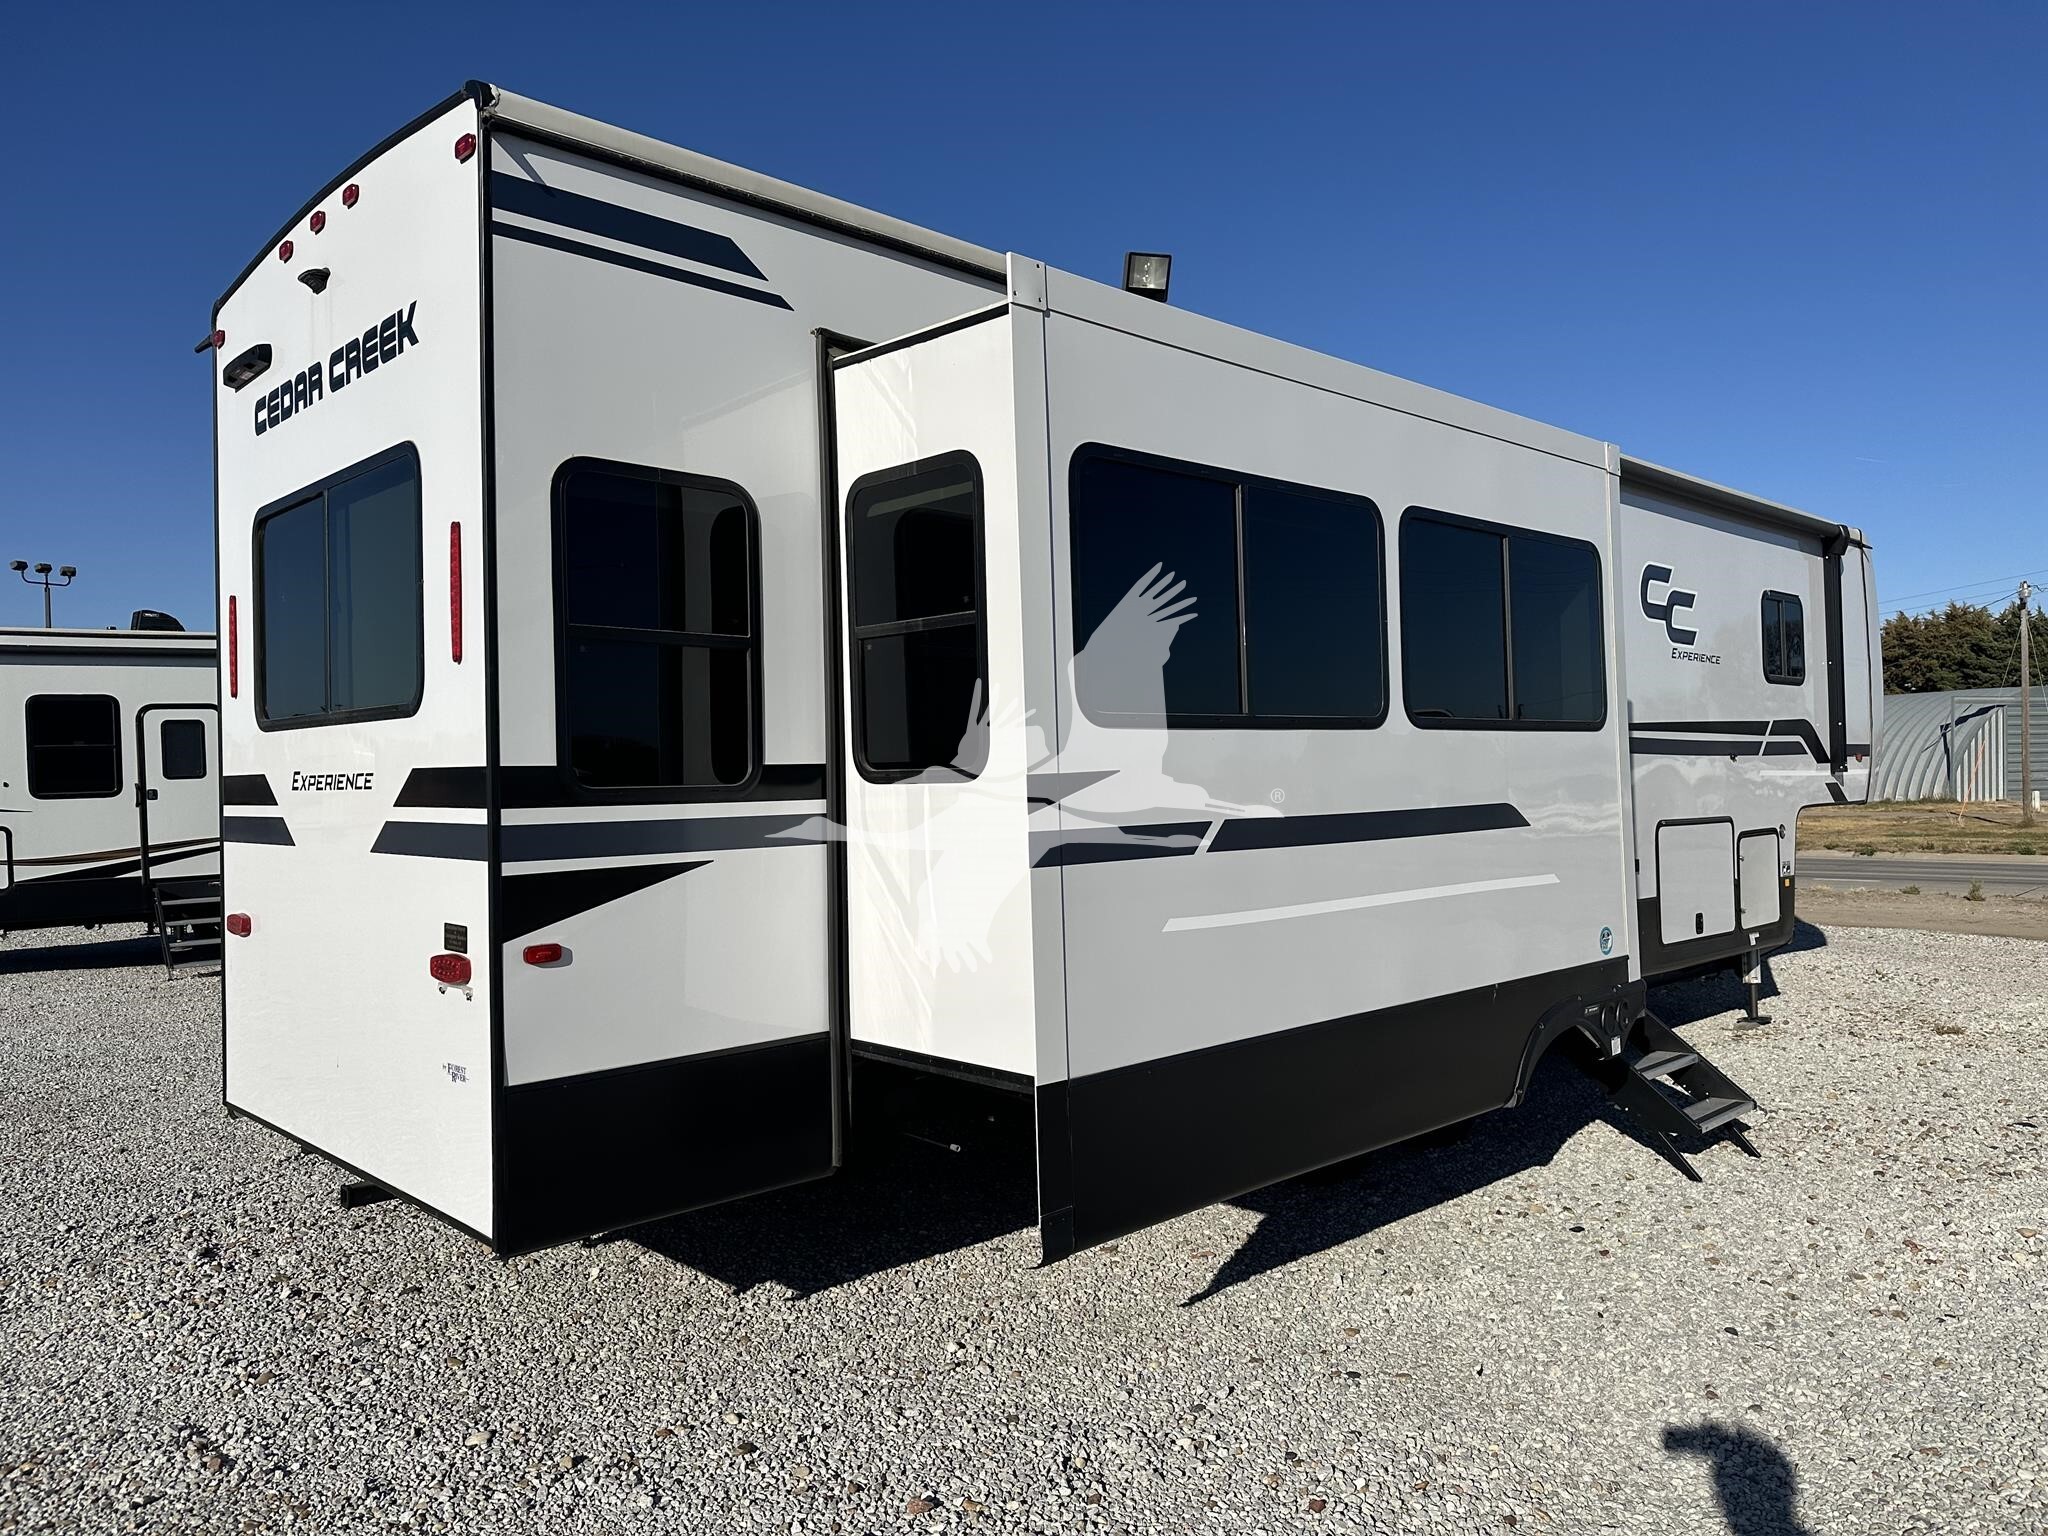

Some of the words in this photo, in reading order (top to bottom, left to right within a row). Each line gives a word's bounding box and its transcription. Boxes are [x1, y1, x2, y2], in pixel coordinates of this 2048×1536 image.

[255, 361, 323, 436] CEDAR
[329, 300, 419, 393] CREEK
[1640, 562, 1698, 647] CC
[1671, 648, 1721, 665] EXPERIENCE
[291, 771, 373, 791] EXPERIENCE
